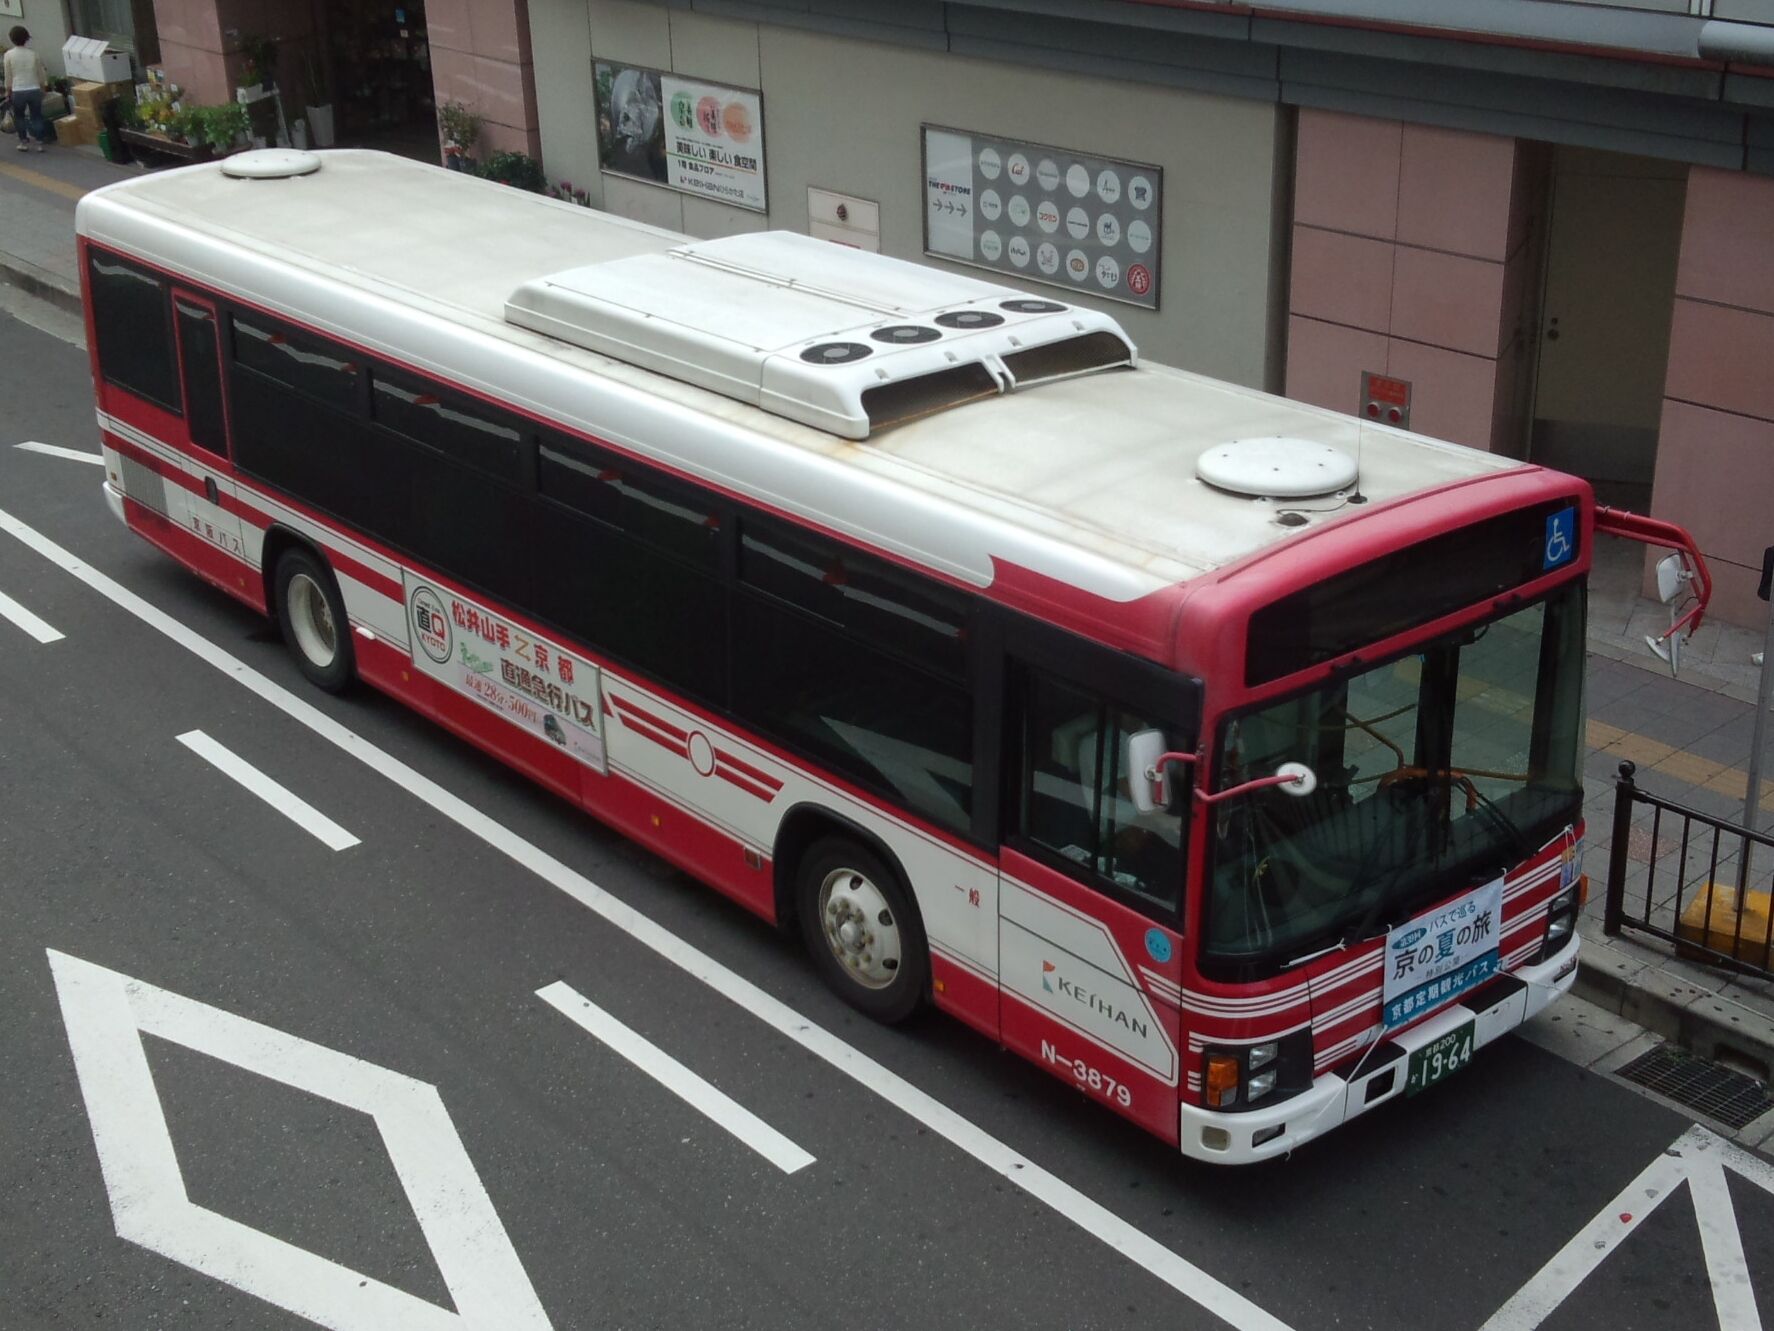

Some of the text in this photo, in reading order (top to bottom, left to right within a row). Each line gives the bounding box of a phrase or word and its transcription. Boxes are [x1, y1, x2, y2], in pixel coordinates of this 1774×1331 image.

[676, 141, 706, 158] 美味しい
[709, 149, 732, 164] 楽しい
[734, 153, 757, 171] 食空間
[421, 632, 446, 652] KYOTO
[451, 599, 511, 652] 松井山手
[533, 644, 575, 687] 京都
[500, 658, 596, 731] 直通急行バス
[954, 884, 981, 907] 一般
[1429, 901, 1476, 933] バスで巡る
[1393, 910, 1492, 980] 京の夏の旅
[1058, 977, 1147, 1039] KEIHAN
[1391, 961, 1489, 1021] 京都定期観光バス
[1041, 1039, 1132, 1107] N-3879
